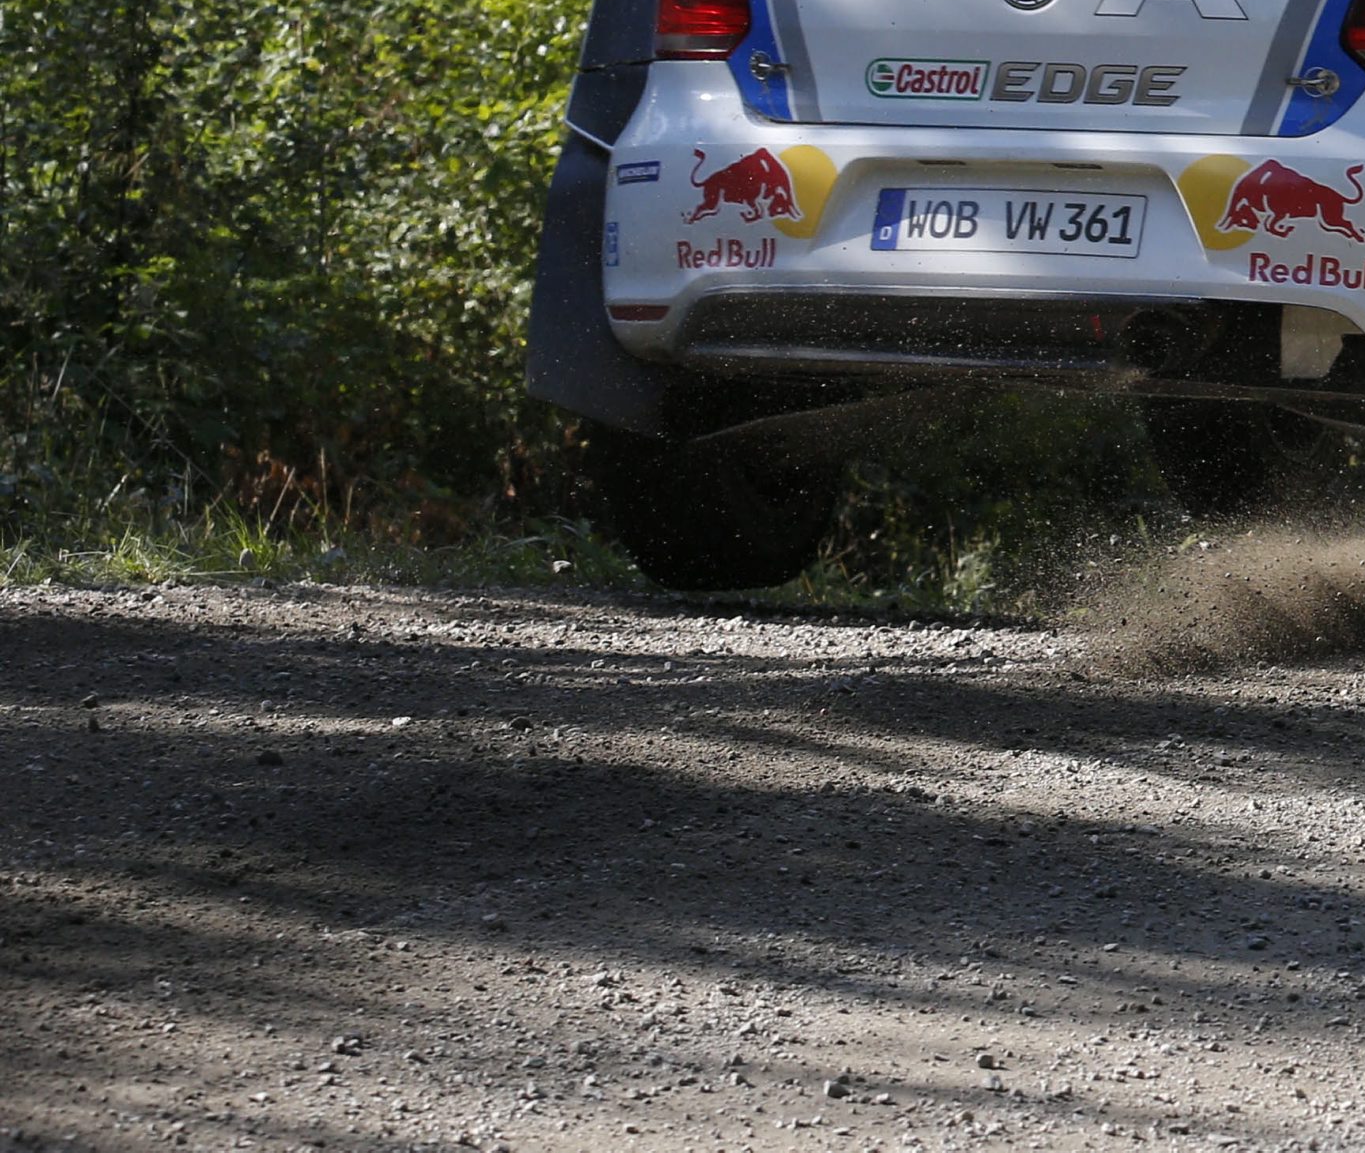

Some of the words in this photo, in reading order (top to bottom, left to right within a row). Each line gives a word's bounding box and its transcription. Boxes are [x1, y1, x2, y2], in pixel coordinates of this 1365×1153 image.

[896, 63, 981, 95] Castrol
[990, 61, 1188, 107] EDGE
[879, 226, 892, 240] D
[907, 200, 980, 239] WOB
[1006, 201, 1055, 240] VW
[1059, 203, 1133, 245] 361
[676, 238, 722, 269] Red
[725, 238, 776, 268] Bull
[1248, 252, 1314, 285] Red
